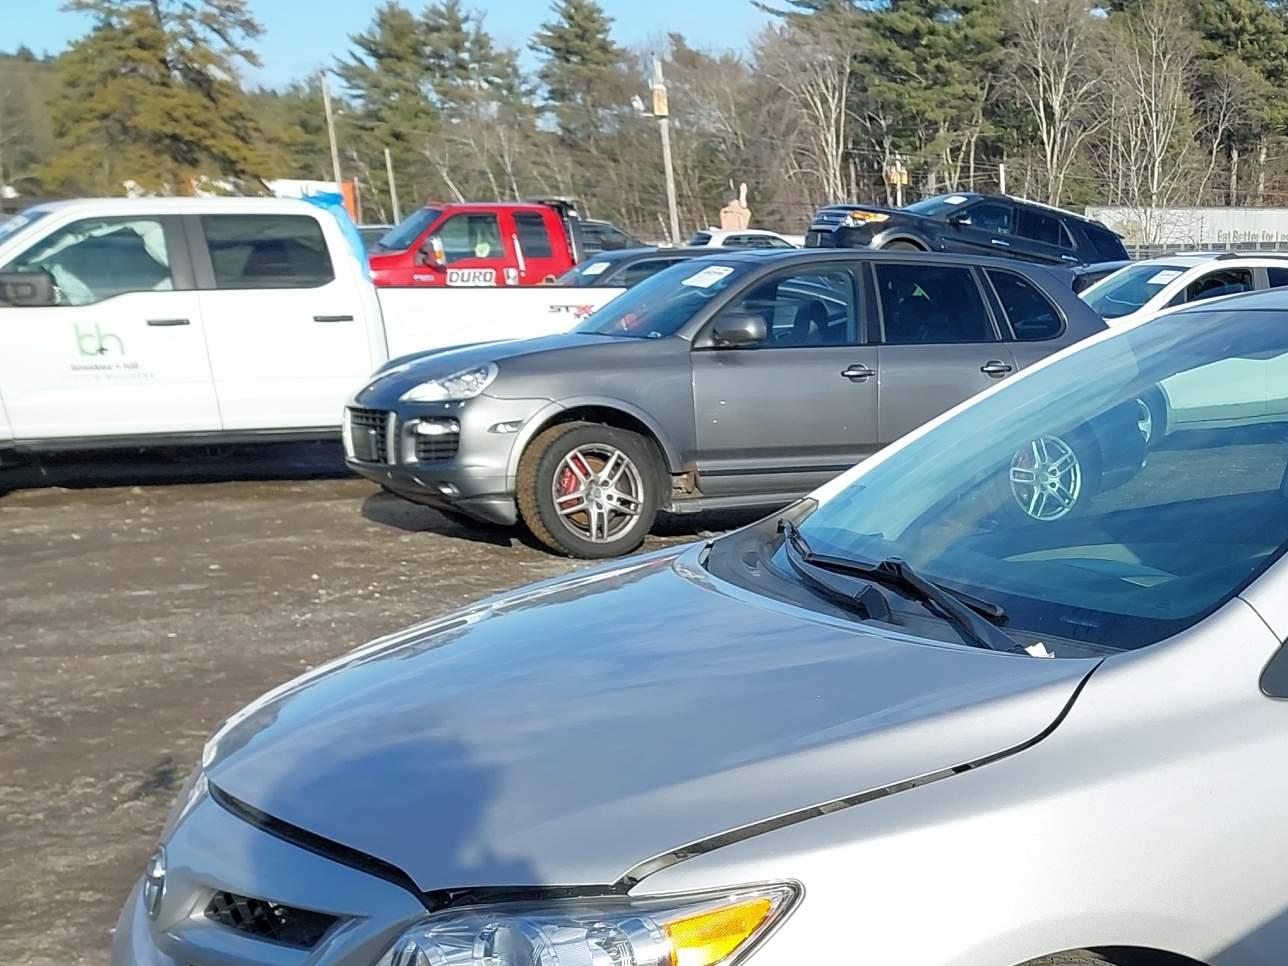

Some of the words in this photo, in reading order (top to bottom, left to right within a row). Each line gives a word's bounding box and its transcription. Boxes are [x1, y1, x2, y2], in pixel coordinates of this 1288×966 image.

[1217, 230, 1230, 242] Eat
[1232, 230, 1259, 242] Better
[449, 271, 493, 283] DURO
